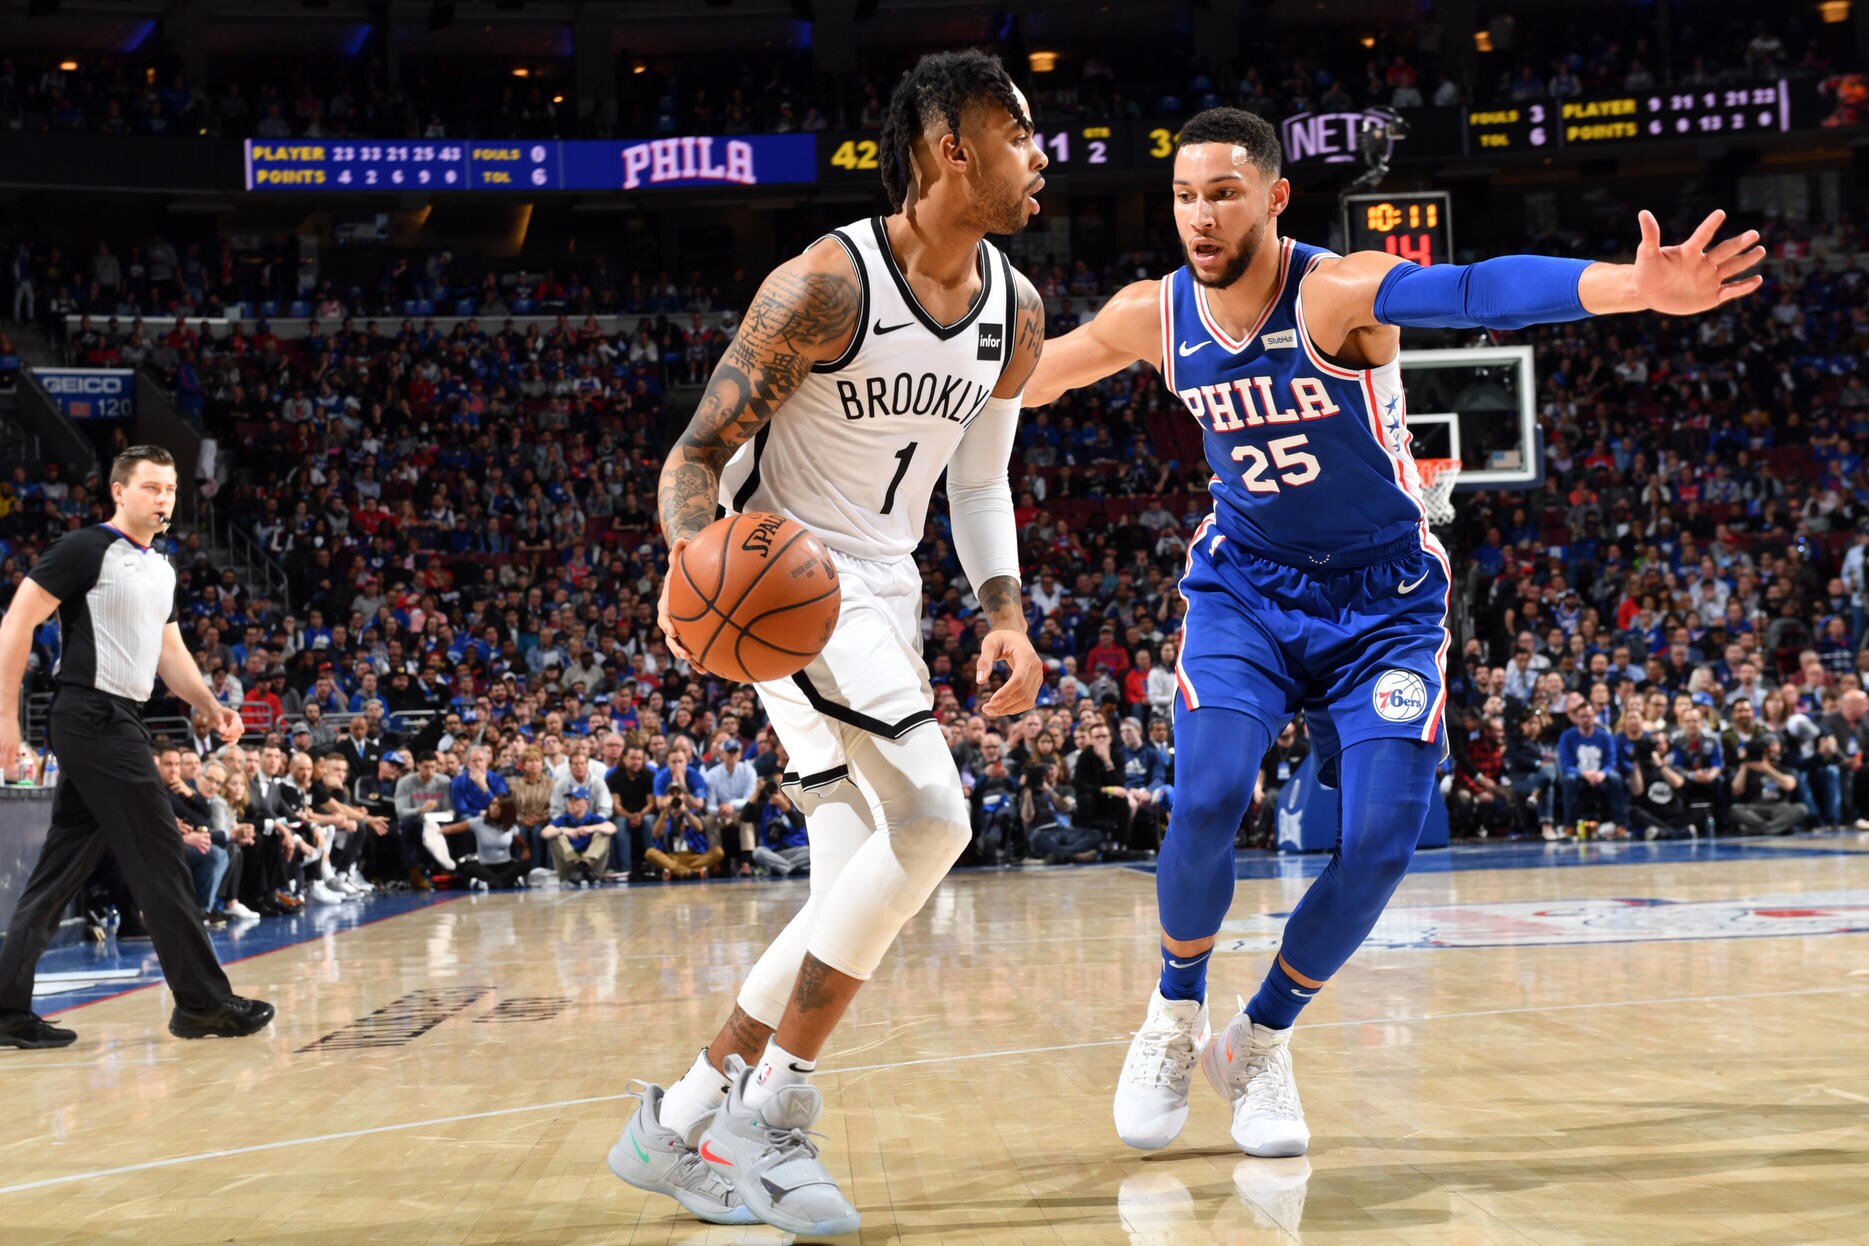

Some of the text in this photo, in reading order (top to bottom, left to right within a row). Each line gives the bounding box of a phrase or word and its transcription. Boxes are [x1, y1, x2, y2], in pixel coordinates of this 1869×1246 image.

[1469, 104, 1545, 126] FOULS 3
[1562, 98, 1637, 119] PLAYER
[1702, 92, 1715, 108] 1
[1291, 112, 1385, 161] NET
[1529, 127, 1546, 146] 6
[1566, 121, 1638, 141] POINTS
[252, 146, 326, 161] PLAYER
[333, 146, 355, 161] 23
[473, 148, 521, 160] FOULS
[1088, 141, 1107, 163] 2
[1149, 128, 1180, 158] 3
[622, 136, 756, 190] PHILA
[831, 140, 879, 169] 42
[257, 169, 326, 184] POINTS
[338, 169, 352, 184] 4
[365, 169, 378, 184] 2
[392, 169, 404, 184] 6
[418, 169, 431, 184] 9
[531, 168, 547, 186] 6
[1367, 203, 1437, 232] 10:11
[1385, 233, 1431, 267] 14
[980, 333, 1001, 348] infor
[1267, 335, 1294, 345] StubHub
[42, 376, 122, 394] GEICO
[97, 397, 133, 417] 120
[837, 372, 990, 429] BROOKLY
[1178, 376, 1340, 432] PHILA
[1230, 433, 1321, 493] 25
[879, 442, 918, 515] 1
[1379, 688, 1421, 709] 76ers
